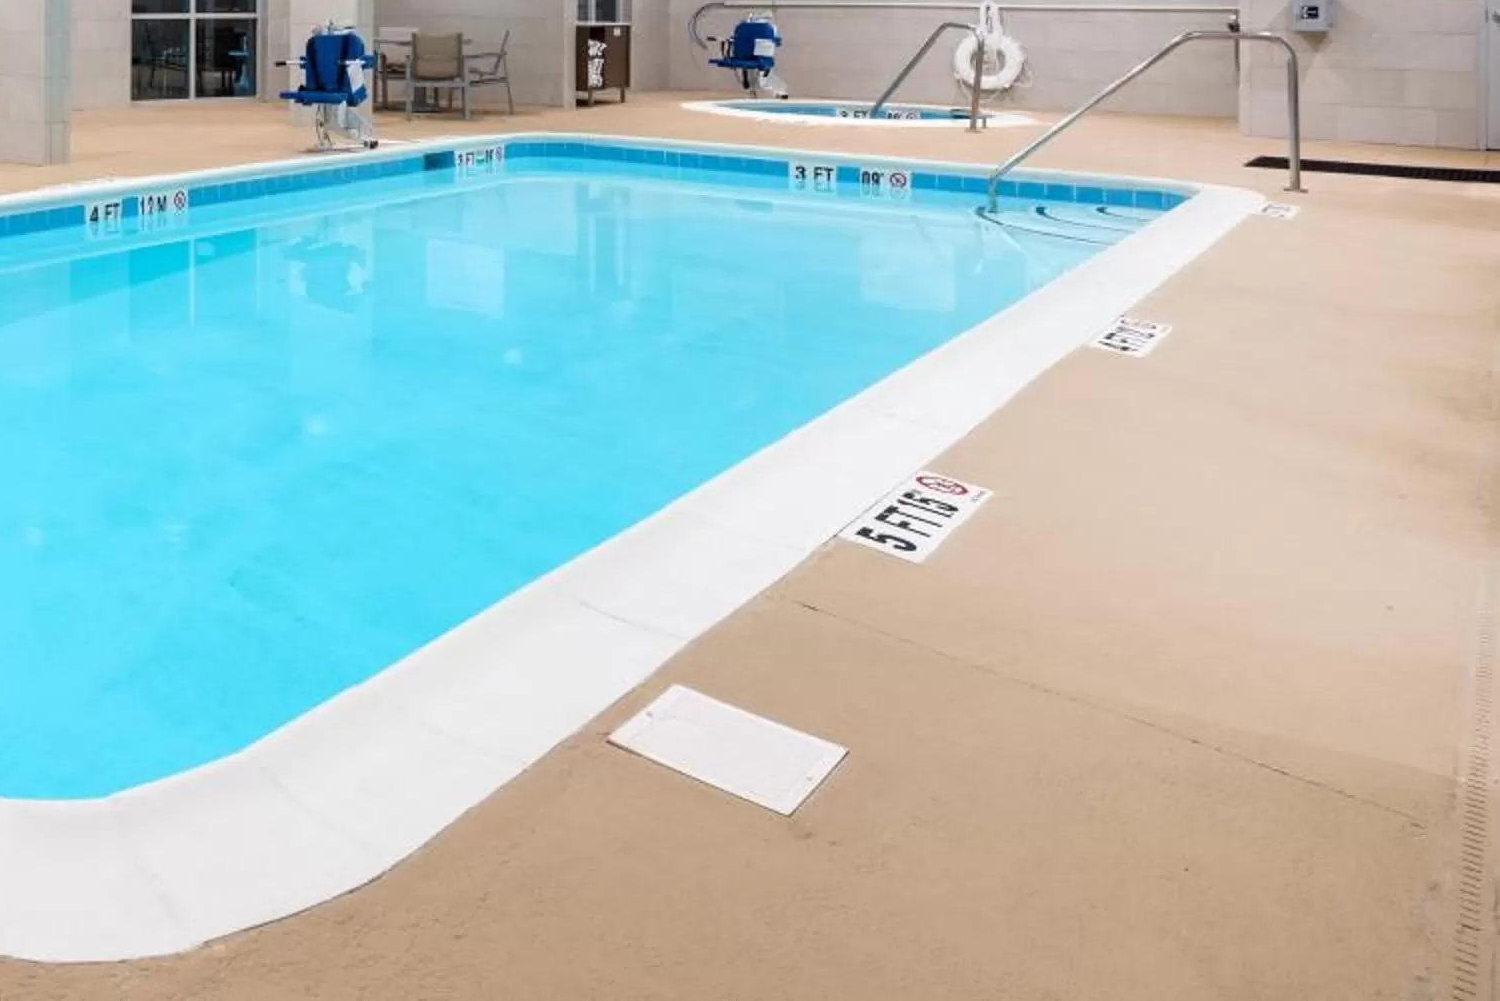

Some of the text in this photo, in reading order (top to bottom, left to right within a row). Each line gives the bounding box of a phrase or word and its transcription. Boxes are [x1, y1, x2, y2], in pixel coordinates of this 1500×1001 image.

[813, 166, 834, 183] FT
[104, 202, 120, 221] FT
[855, 526, 917, 552] 5
